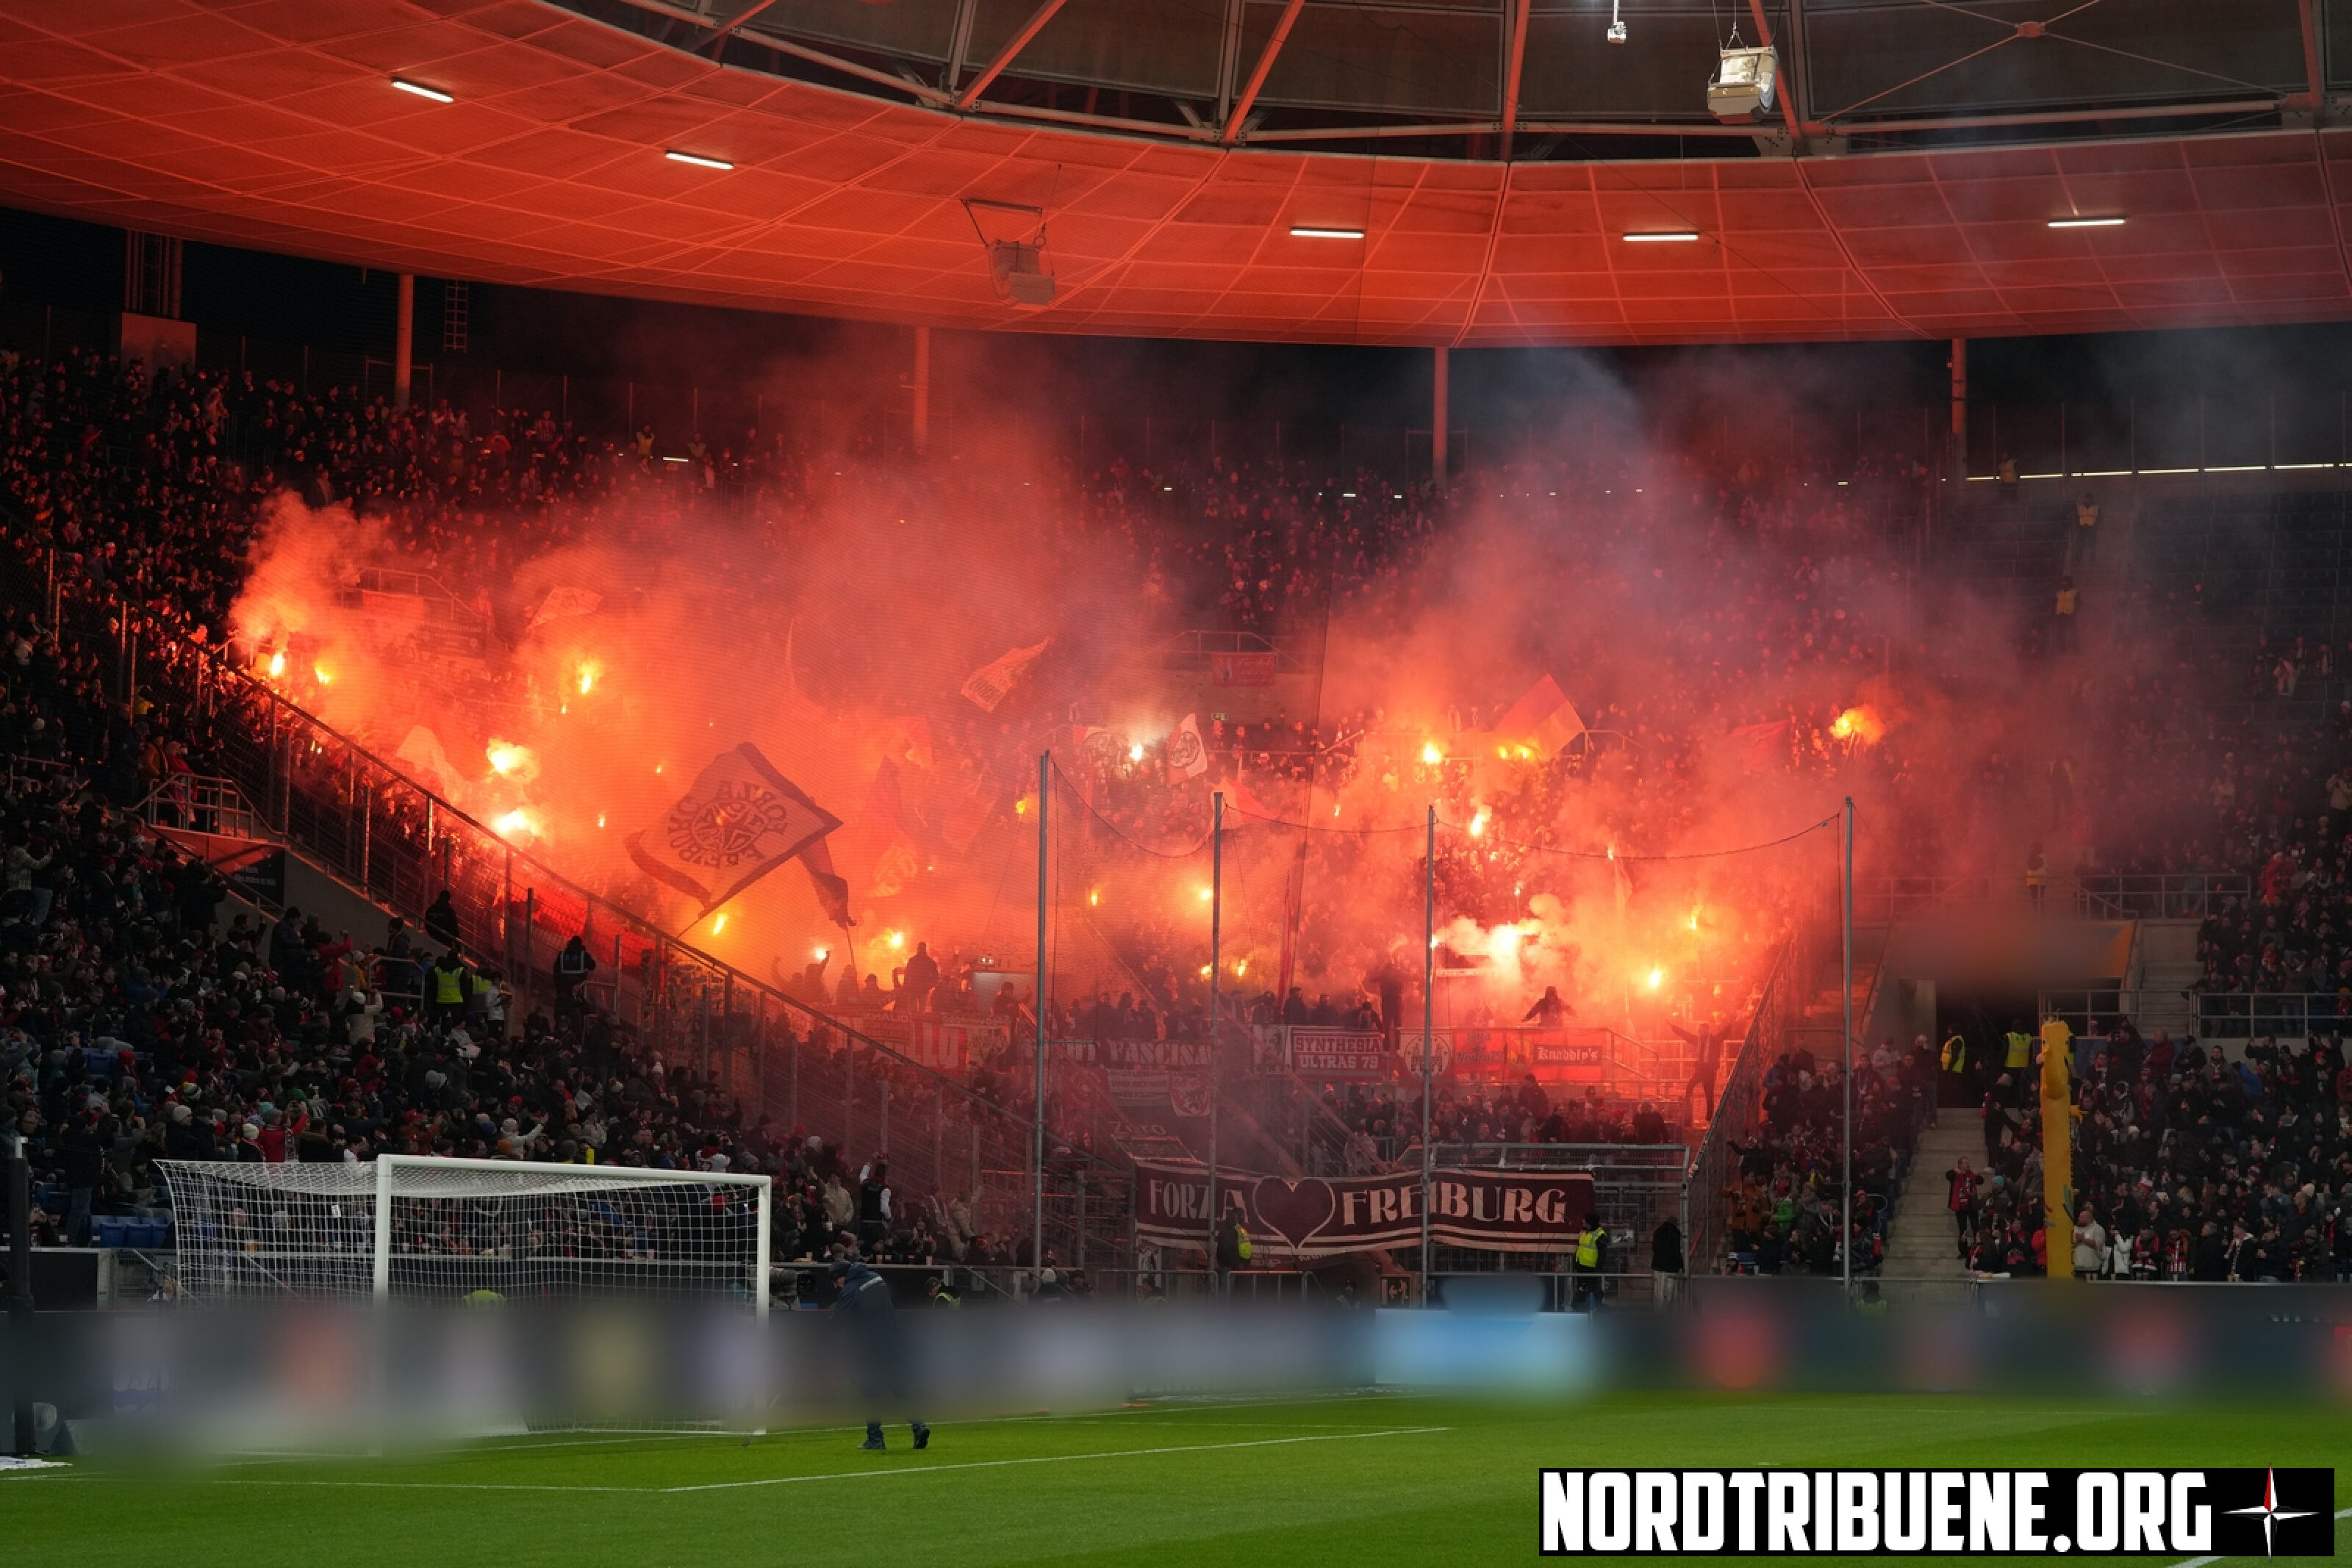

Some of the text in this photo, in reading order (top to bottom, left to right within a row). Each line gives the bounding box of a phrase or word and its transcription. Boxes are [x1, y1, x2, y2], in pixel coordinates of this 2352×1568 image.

[1294, 1036, 1382, 1054] SYNTHESIA
[1299, 1054, 1378, 1068] ULTRAS 79
[1150, 1179, 1566, 1226] FORZA FREIBURG
